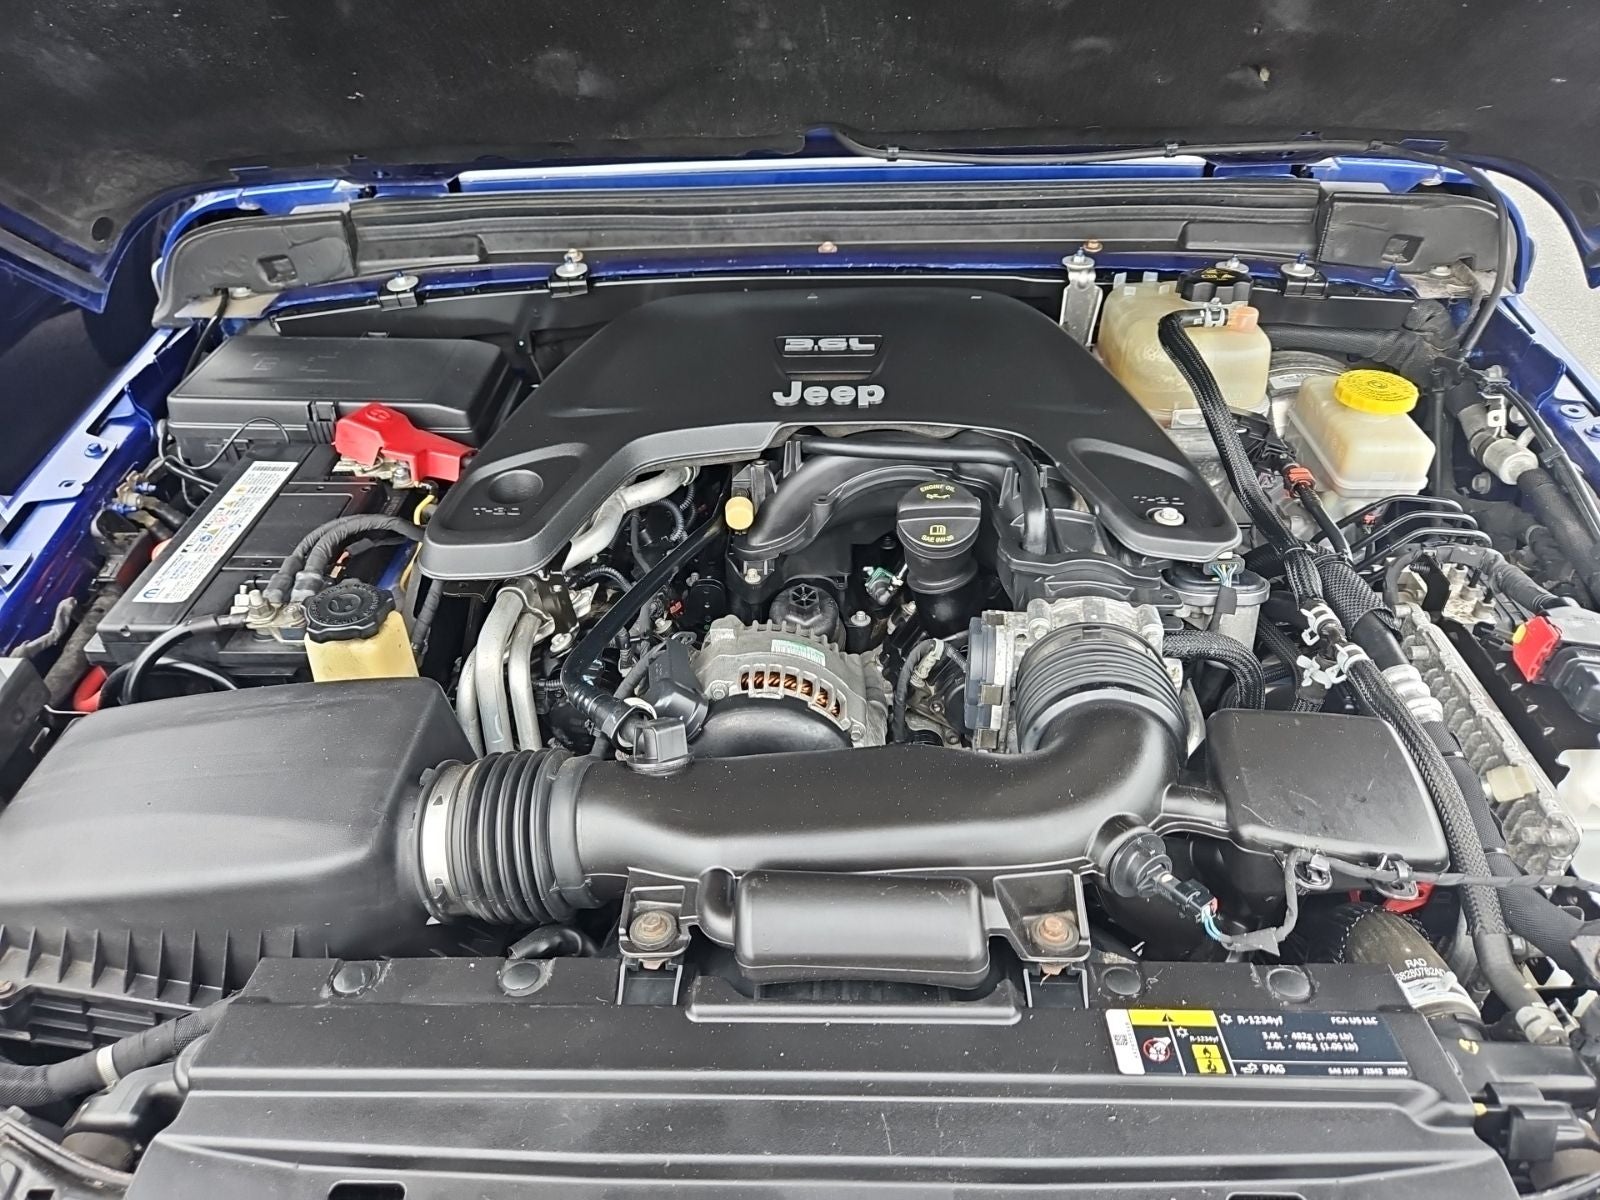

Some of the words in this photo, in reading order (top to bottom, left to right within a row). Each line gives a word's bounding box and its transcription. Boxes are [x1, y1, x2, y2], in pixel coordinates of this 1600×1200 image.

[784, 338, 876, 352] 3.6L
[772, 381, 886, 408] Jeep
[920, 484, 944, 493] ENGINE
[945, 485, 956, 493] OIL
[921, 534, 935, 543] SAE
[1404, 957, 1427, 969] RAD
[1236, 1015, 1283, 1027] R-1234yf
[1261, 1063, 1286, 1075] PAG
